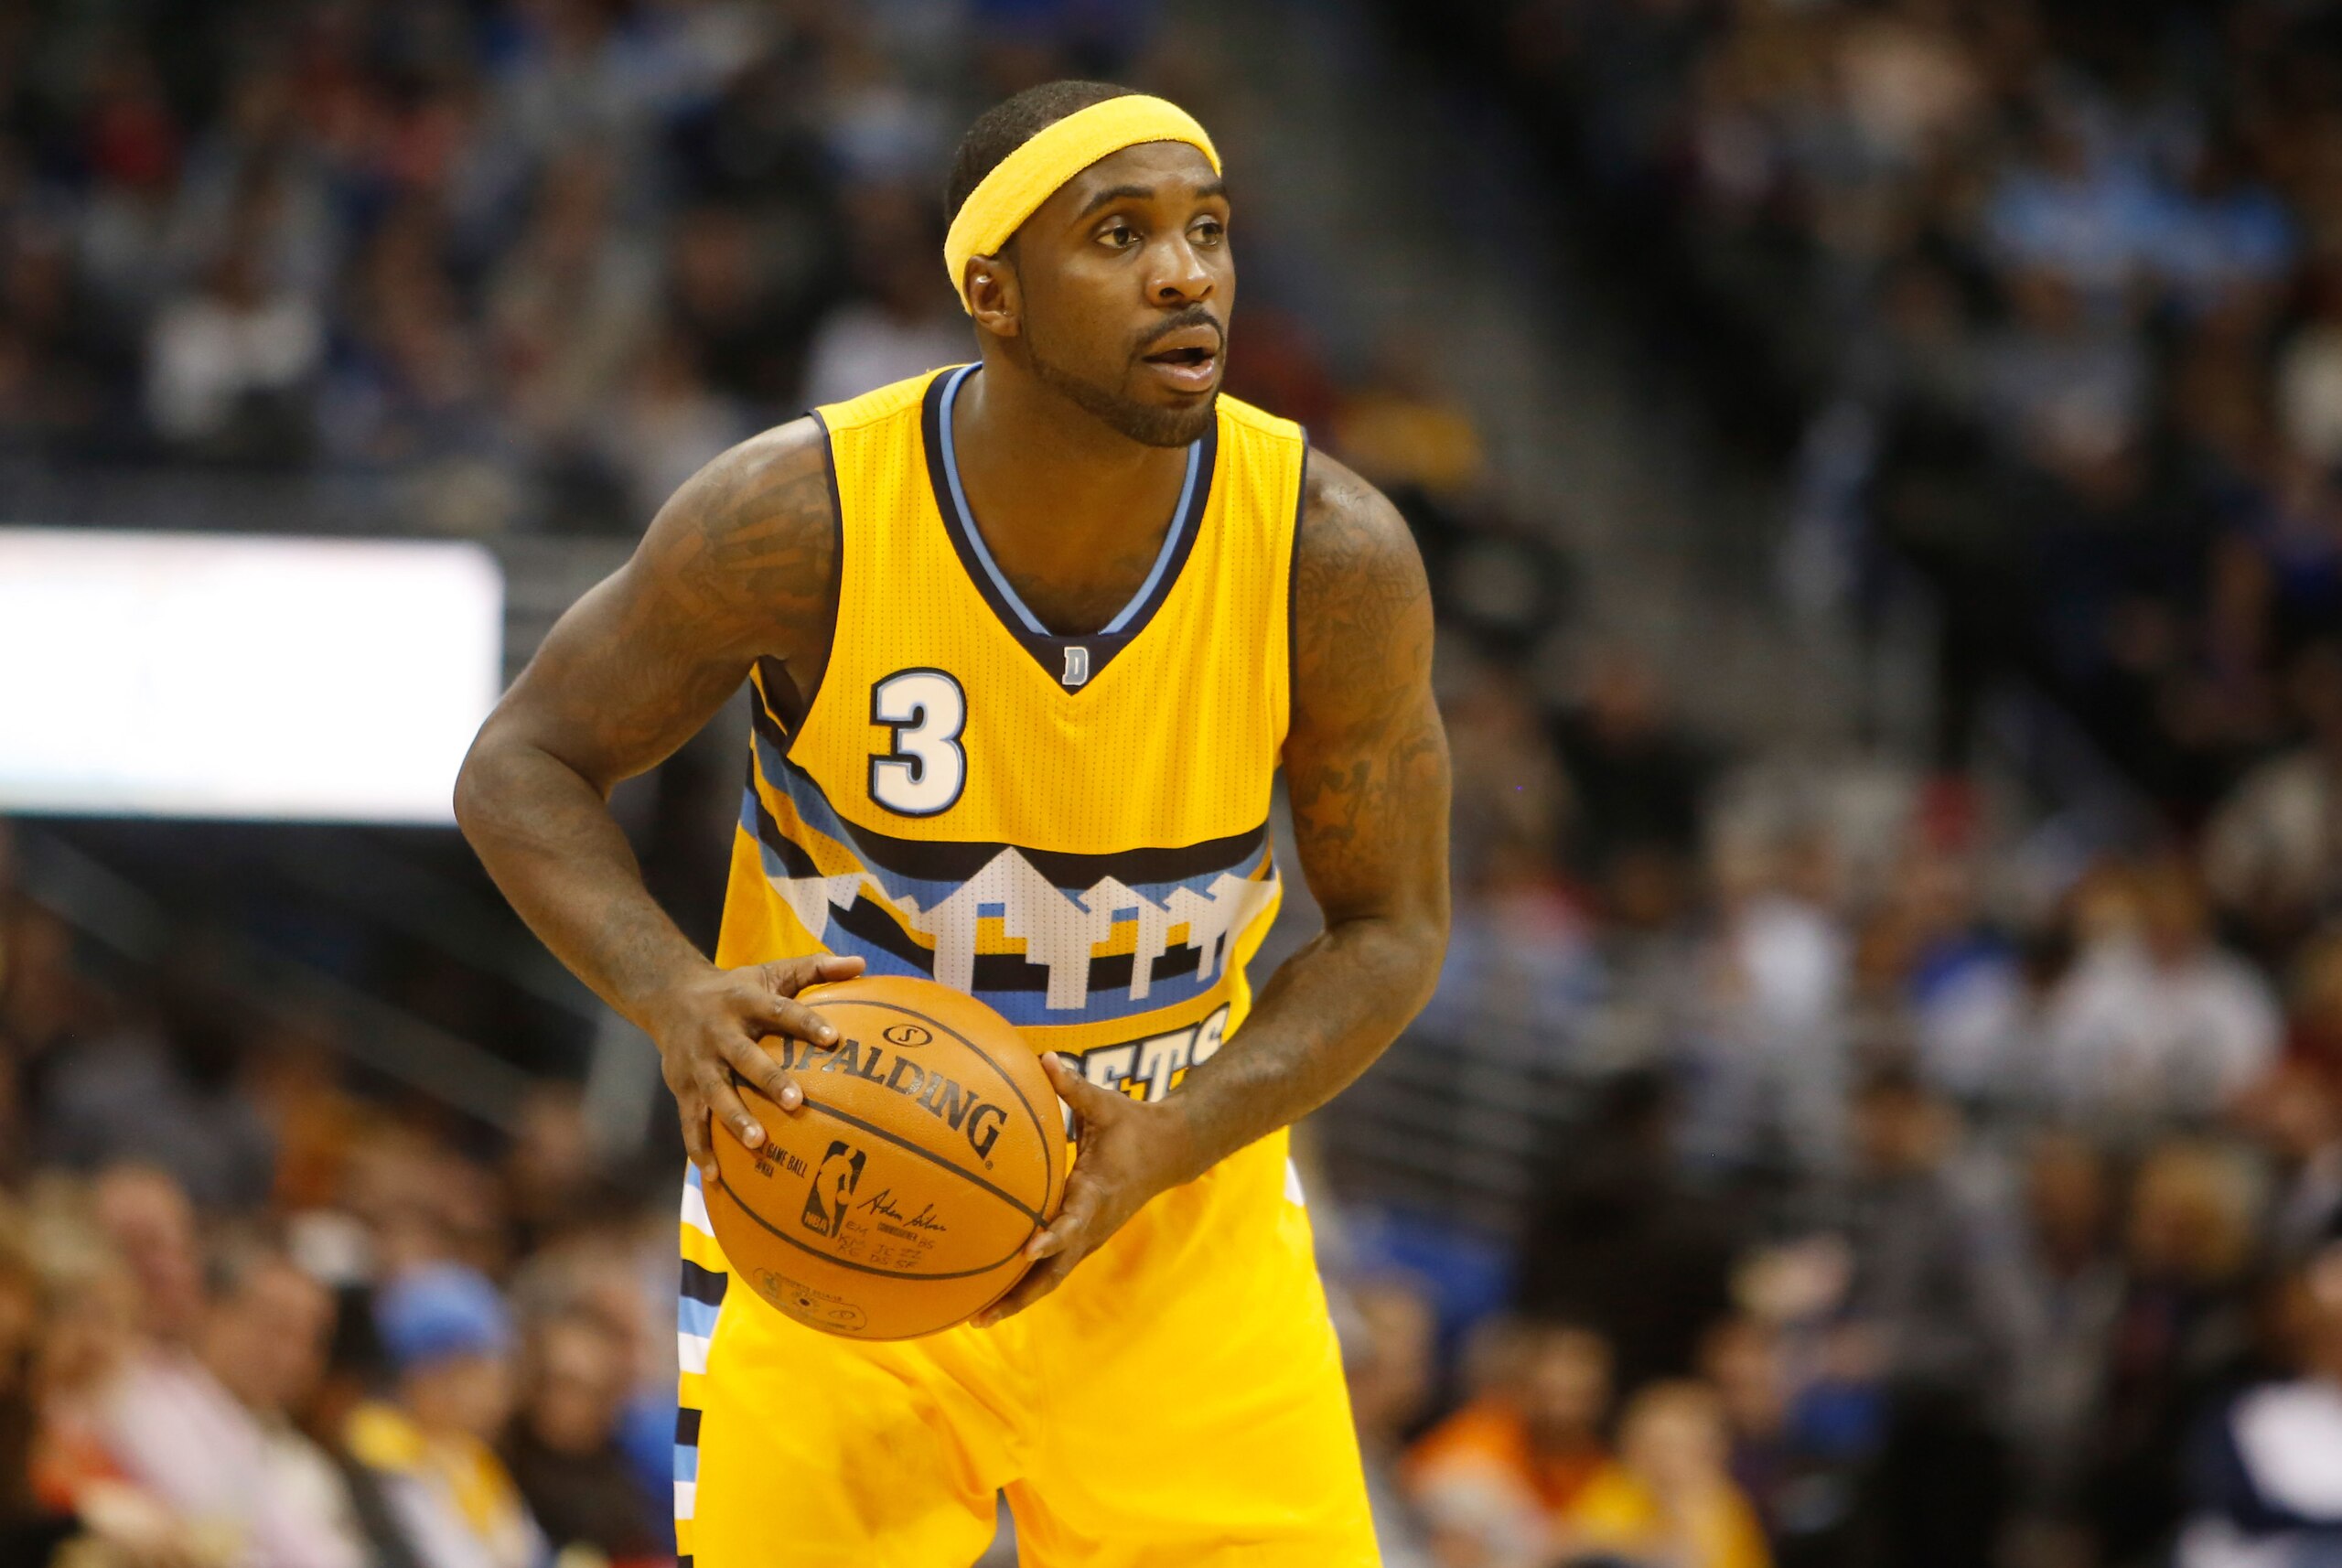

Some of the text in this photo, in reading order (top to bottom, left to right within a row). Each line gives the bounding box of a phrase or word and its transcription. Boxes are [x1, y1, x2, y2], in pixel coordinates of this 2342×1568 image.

[1061, 645, 1089, 686] D
[866, 666, 967, 818] 3
[1039, 1001, 1230, 1121] ETS
[767, 1143, 789, 1166] GAME
[787, 1155, 808, 1178] BALL
[804, 1211, 828, 1232] NBA
